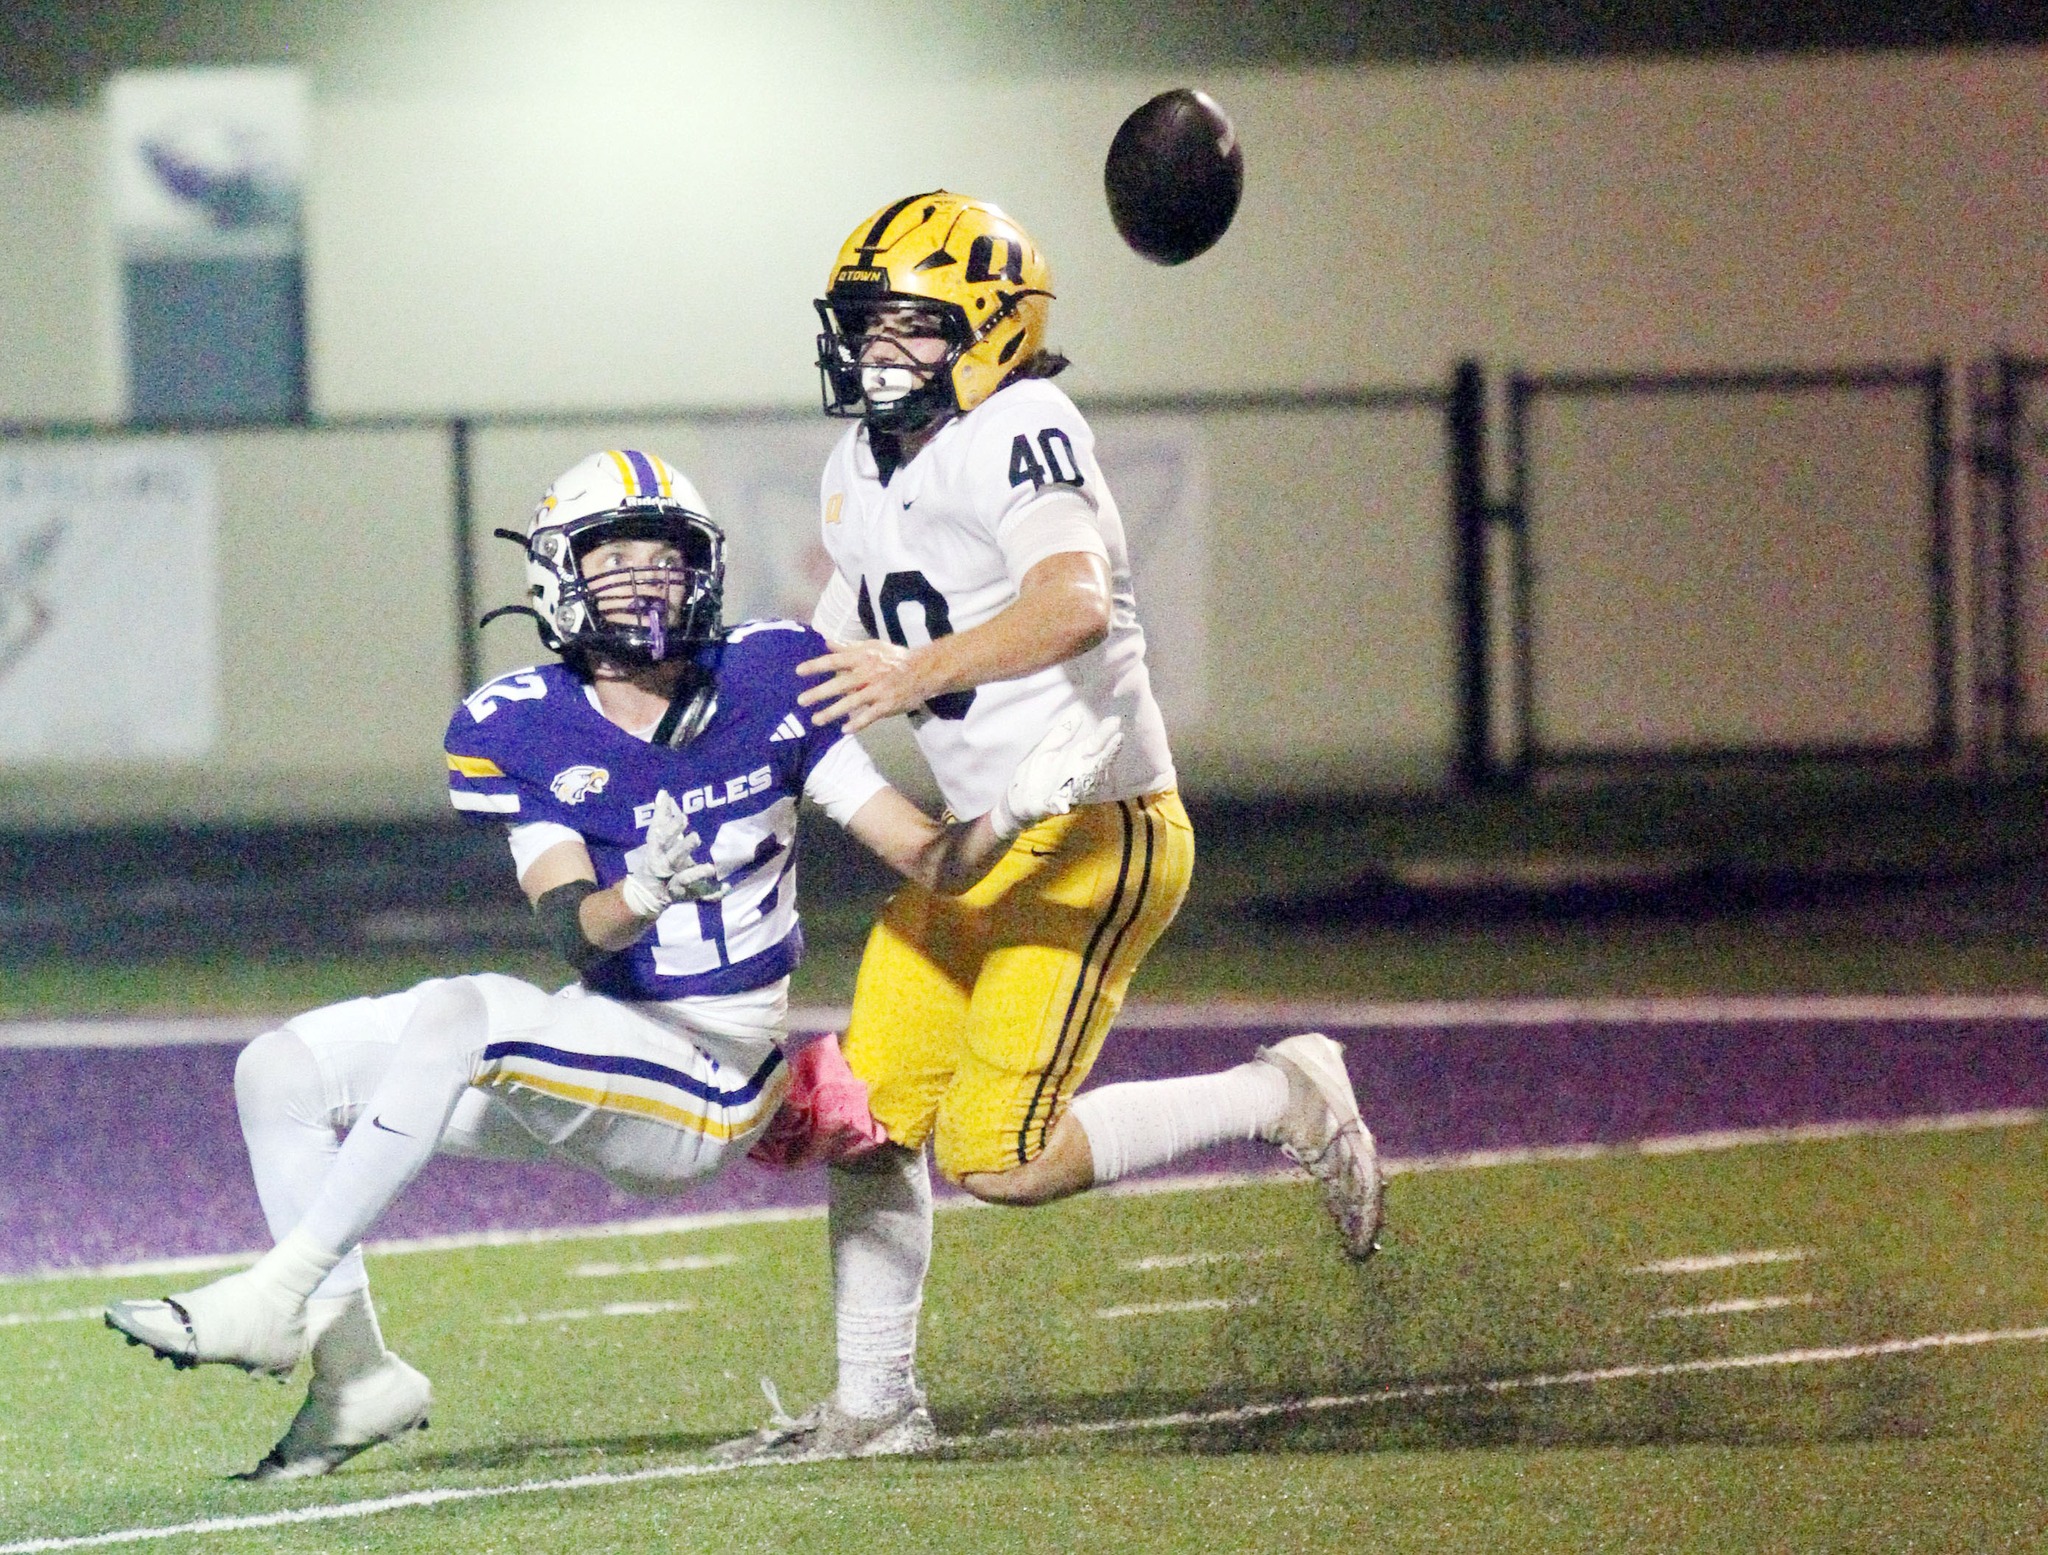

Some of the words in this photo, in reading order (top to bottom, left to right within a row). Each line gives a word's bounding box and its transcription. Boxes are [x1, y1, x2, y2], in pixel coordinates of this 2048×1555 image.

[1008, 427, 1084, 491] 40
[857, 569, 977, 720] 0
[632, 765, 772, 829] EGLES
